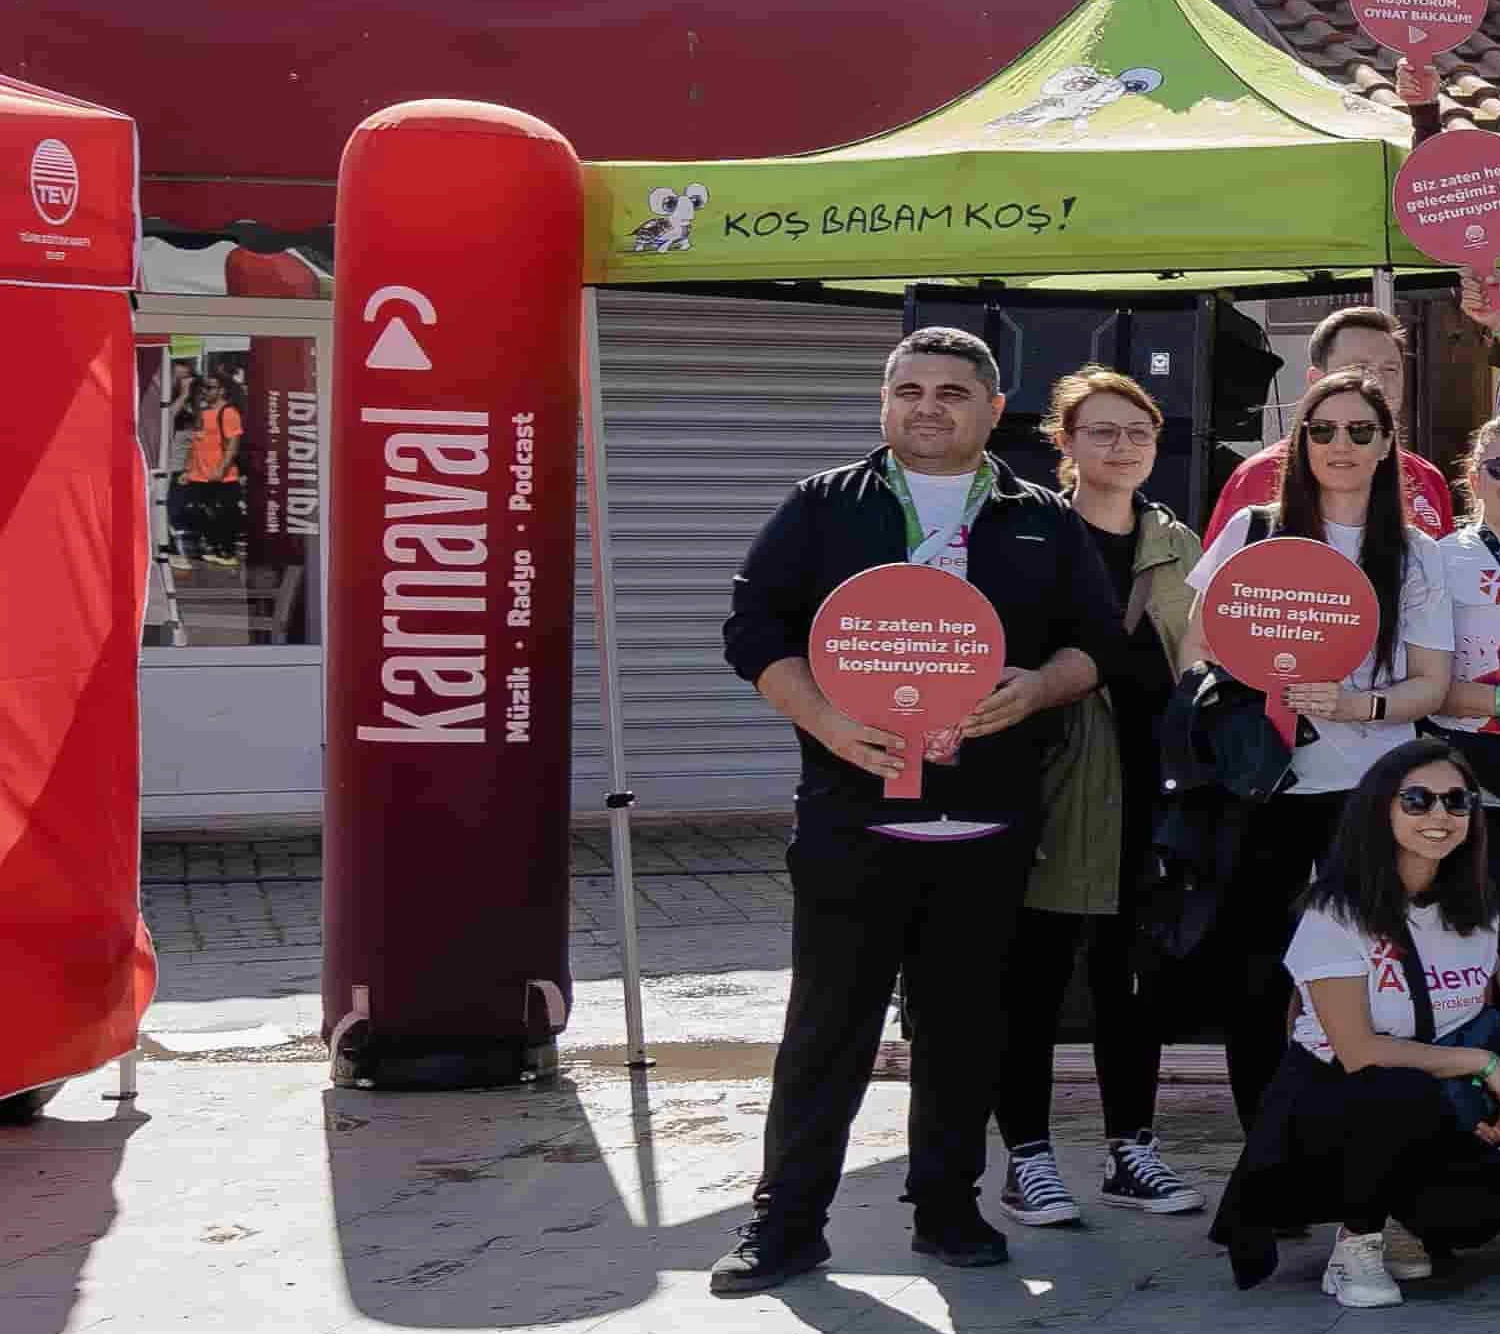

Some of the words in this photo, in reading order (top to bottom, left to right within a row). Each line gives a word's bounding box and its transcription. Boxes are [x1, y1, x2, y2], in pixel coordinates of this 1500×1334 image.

[1364, 8, 1408, 21] OYNAT
[37, 184, 74, 205] TEV
[1412, 179, 1437, 195] Biz
[1439, 171, 1481, 189] zaten
[724, 212, 809, 240] KOŞ
[821, 204, 952, 235] BABAM
[964, 196, 1077, 234] KOŞ!
[509, 412, 535, 512] Podcast
[357, 407, 489, 743] karnaval
[507, 548, 536, 628] Radyo
[1231, 582, 1352, 607] Tempomuzu
[1216, 600, 1281, 621] eğitim
[1286, 605, 1361, 627] aşkımız
[839, 616, 872, 632] Biz
[878, 618, 933, 634] zaten
[938, 617, 977, 637] hep
[1250, 622, 1326, 643] belirler.
[825, 635, 949, 656] geleceğimiz
[953, 638, 991, 655] için
[838, 655, 976, 676] koşturuyoruz.
[505, 666, 530, 743] Müzik
[1377, 964, 1490, 994] Adem
